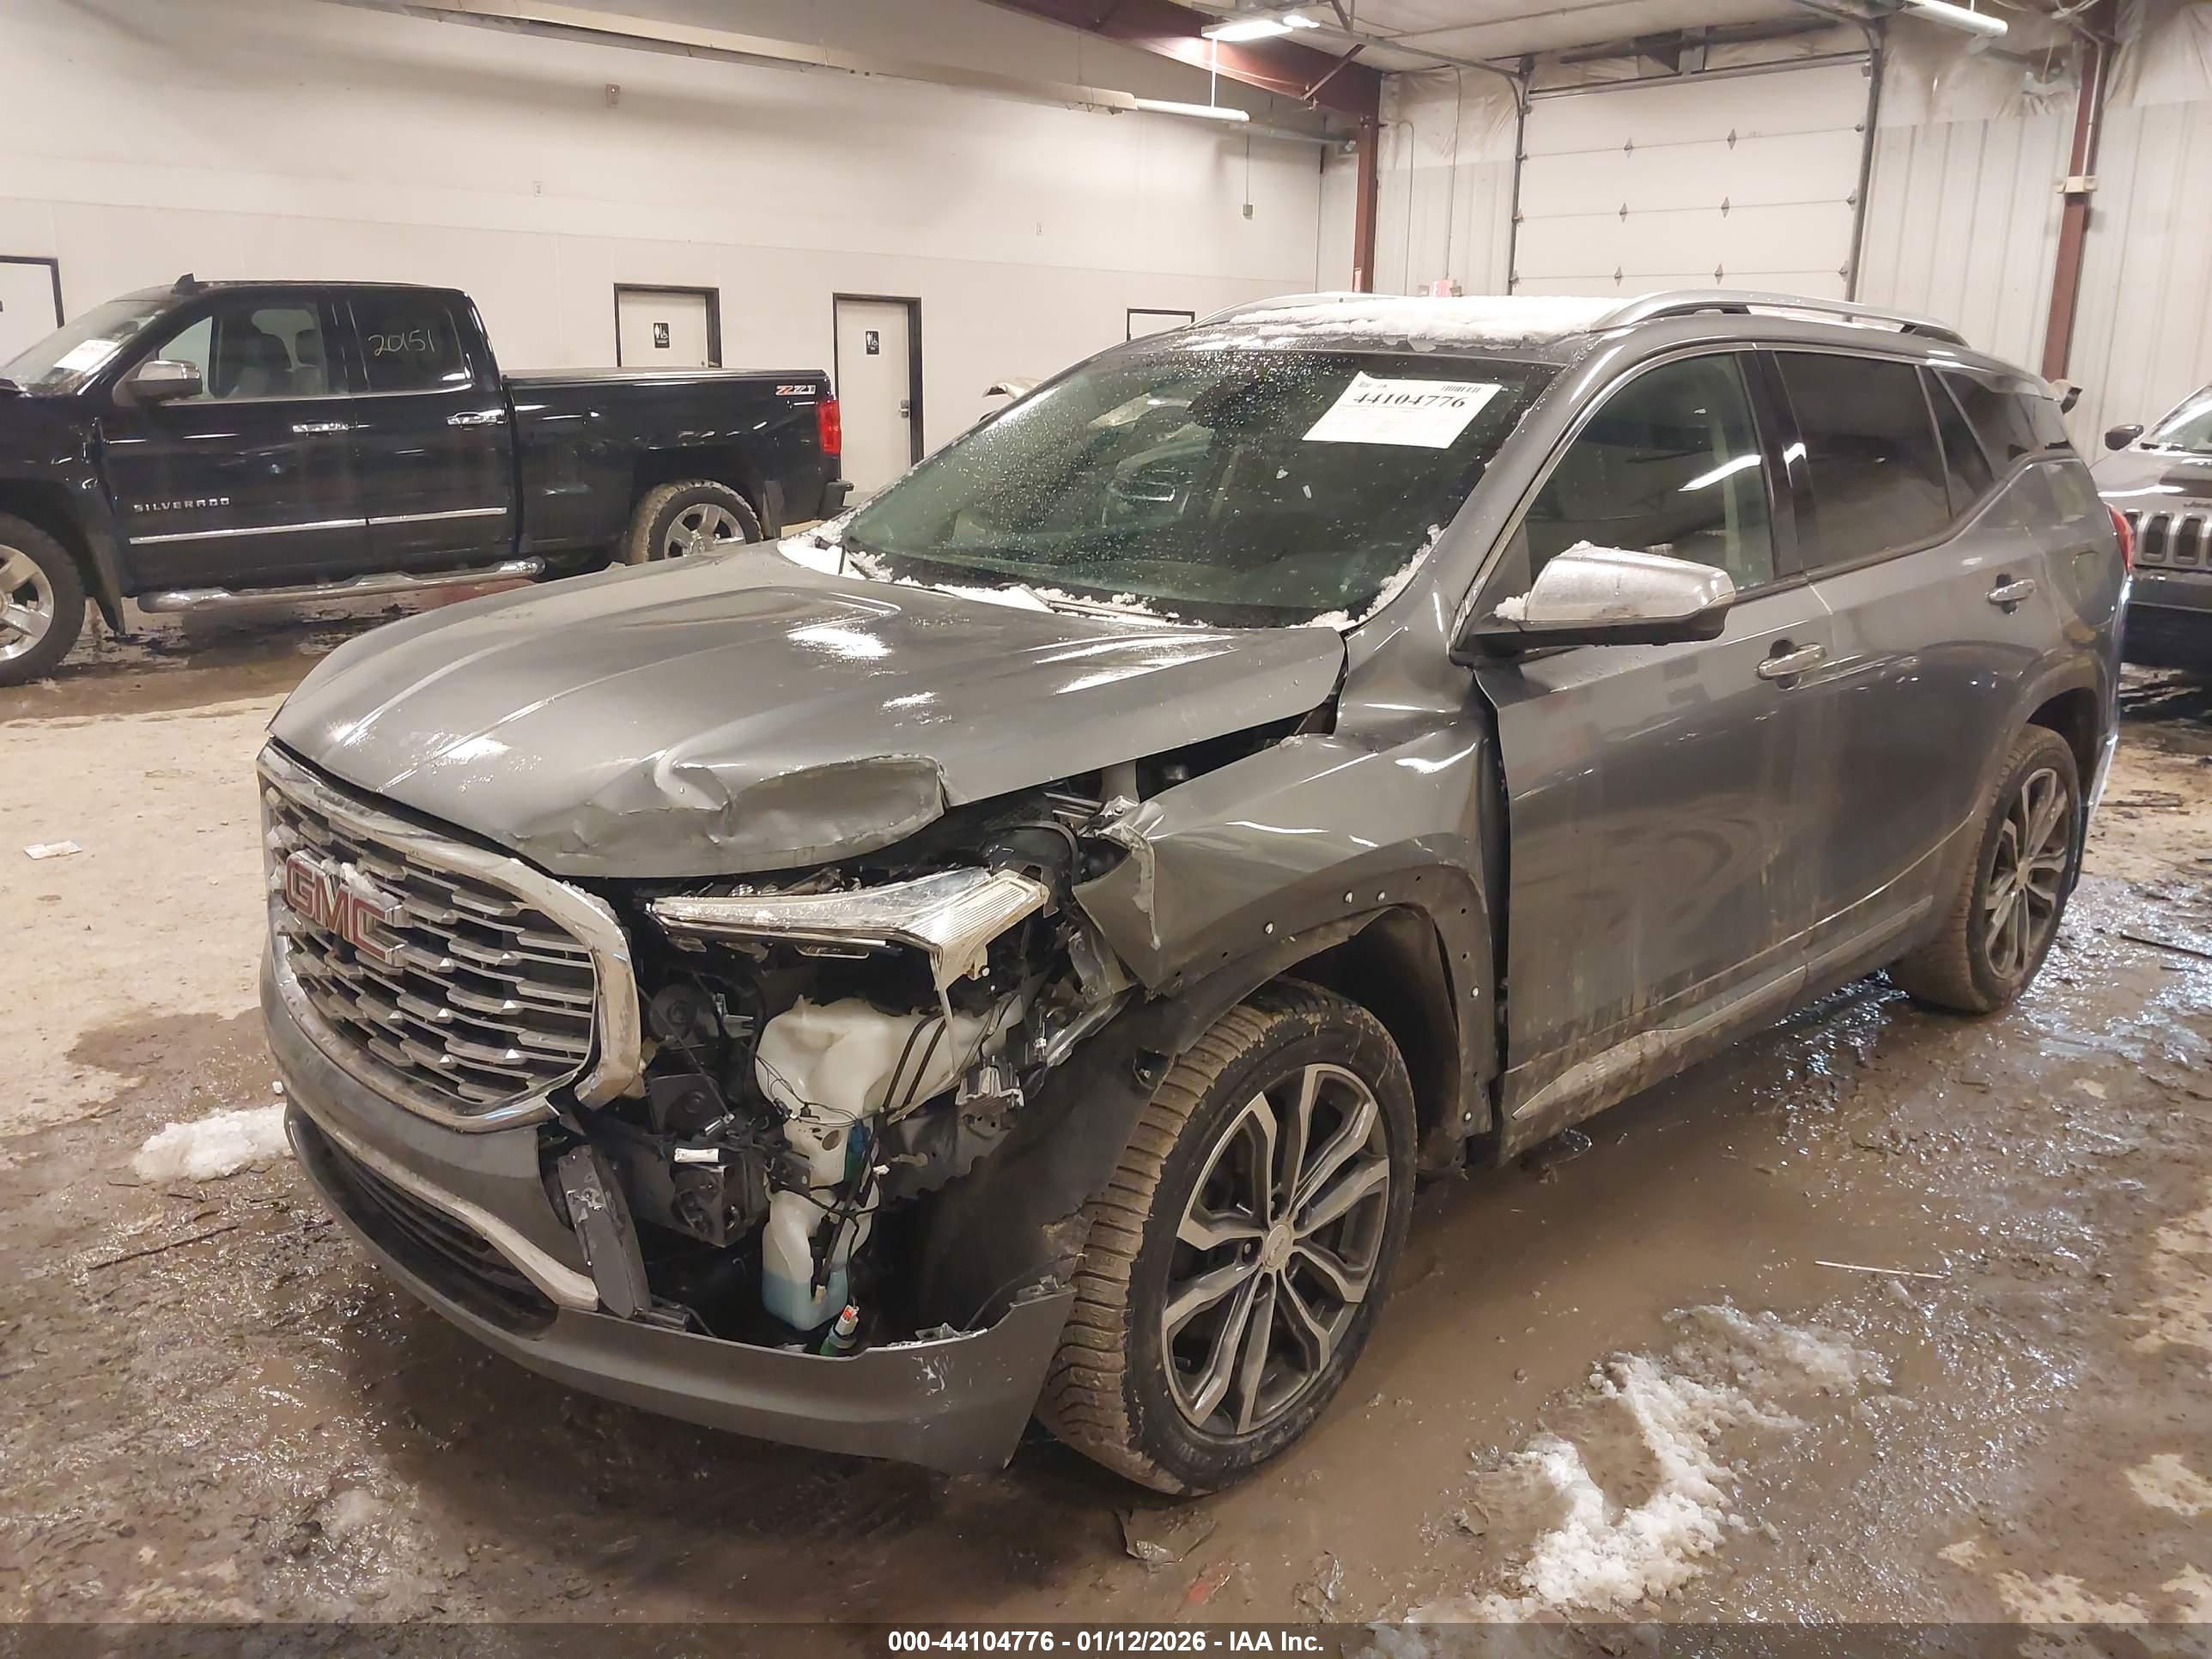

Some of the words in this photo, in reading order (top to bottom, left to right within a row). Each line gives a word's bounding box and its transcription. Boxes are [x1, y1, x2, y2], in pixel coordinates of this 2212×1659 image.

[775, 385, 817, 396] Z71
[1352, 392, 1468, 409] 44104776
[133, 497, 230, 513] SILVERADO
[286, 852, 397, 965] GMC
